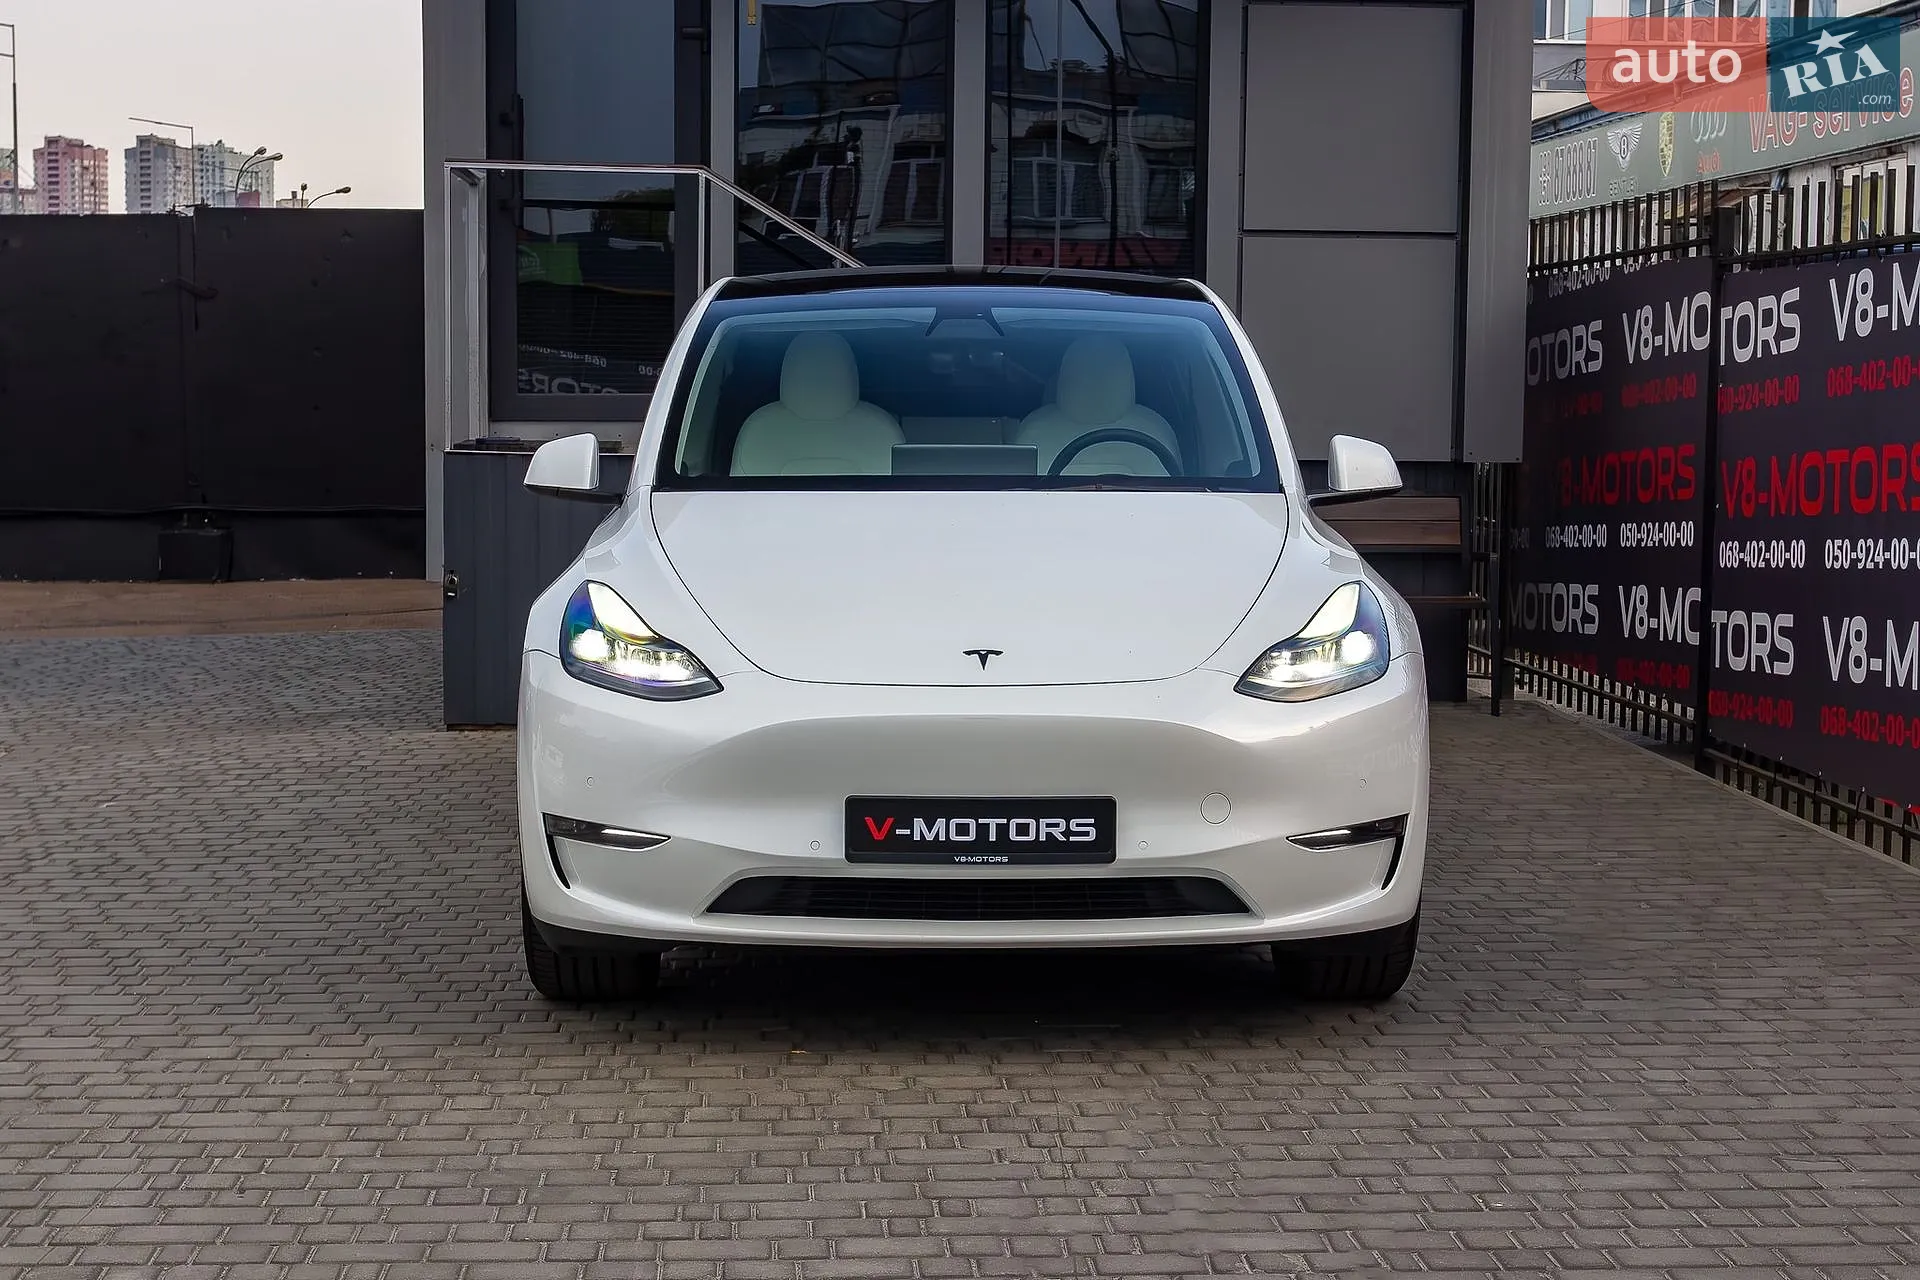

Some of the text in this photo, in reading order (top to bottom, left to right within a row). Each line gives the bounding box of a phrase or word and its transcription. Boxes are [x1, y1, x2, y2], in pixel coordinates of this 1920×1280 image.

[1622, 291, 1711, 365] V8-MO
[1827, 355, 1920, 398] 068-402-00-
[1545, 523, 1607, 548] 068-402-00-00
[1620, 521, 1695, 547] 050-924-00-00
[1719, 539, 1806, 569] 068-402-00-00
[1711, 610, 1919, 690] TORS V8-M
[864, 817, 1097, 841] V-MOTORS
[954, 855, 1009, 863] V8-MOTORS
